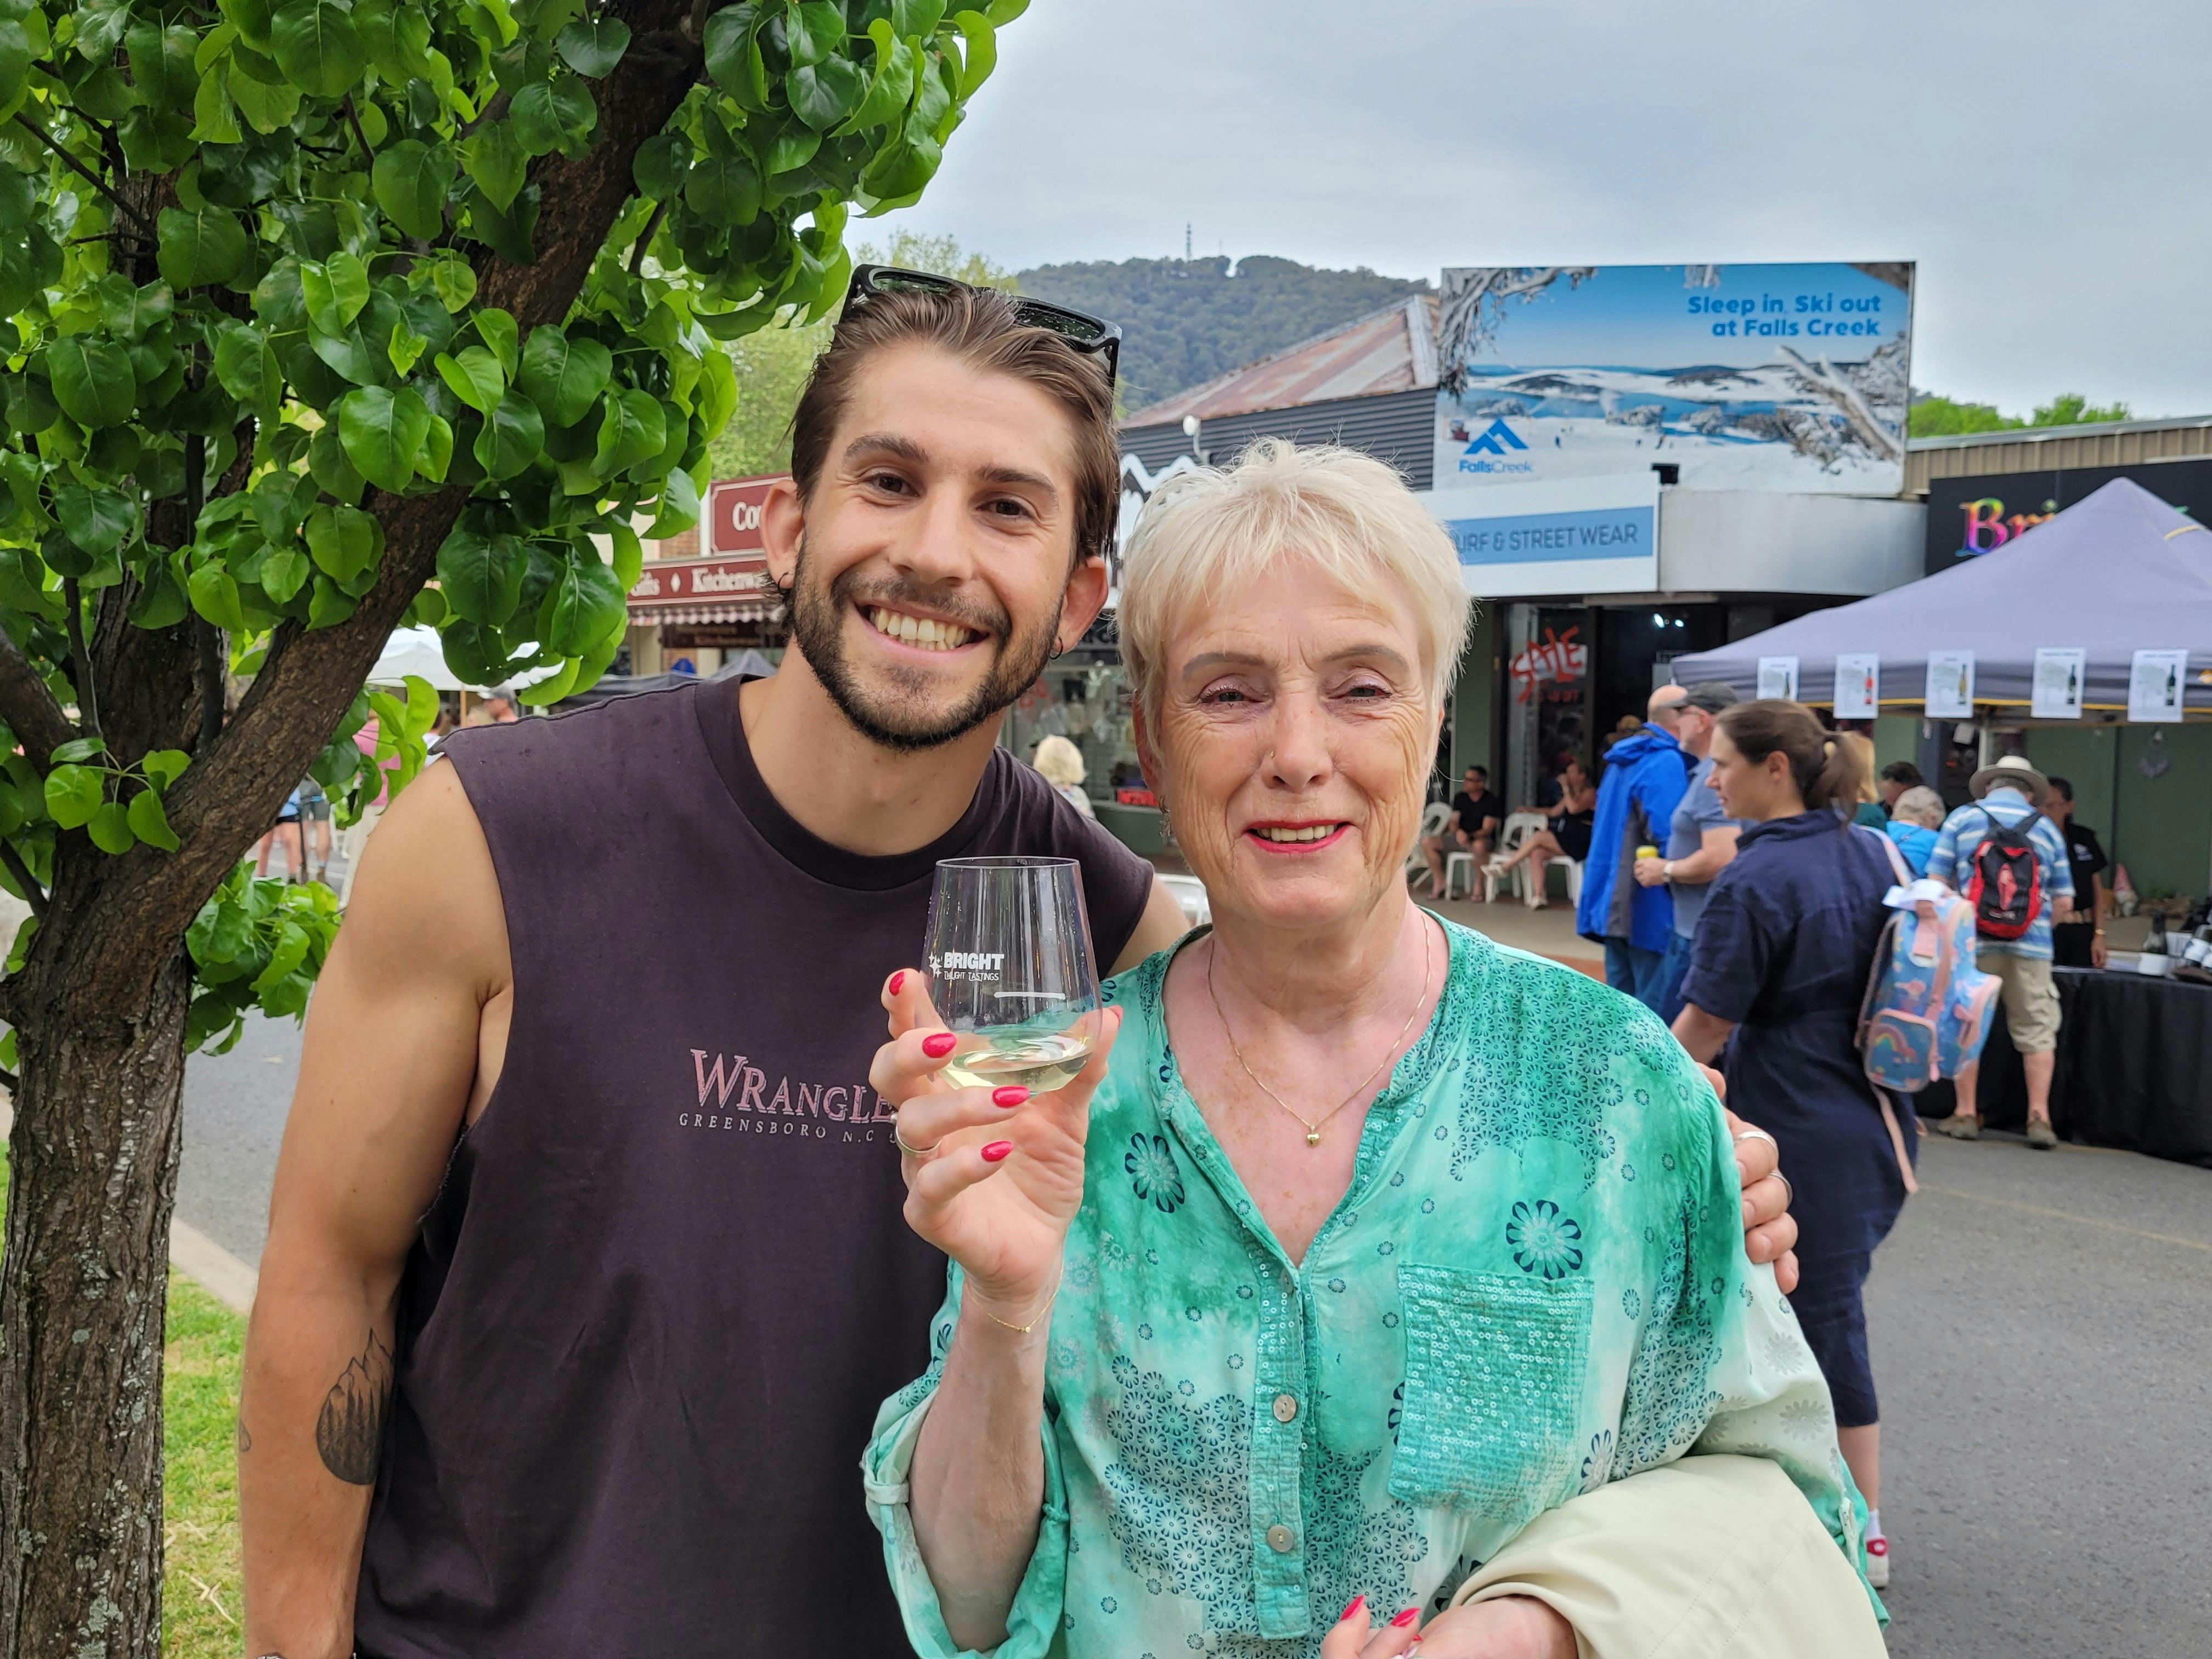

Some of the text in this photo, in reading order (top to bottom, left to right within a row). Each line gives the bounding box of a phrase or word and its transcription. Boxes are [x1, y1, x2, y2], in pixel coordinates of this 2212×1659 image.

[1688, 292, 1881, 316] Sleep in Ski out
[1712, 319, 1880, 337] at Falls Creek
[1492, 531, 1505, 552] &
[1509, 526, 1576, 551] STREET
[1579, 522, 1639, 546] WEAR
[1510, 627, 1582, 704] SALE
[944, 952, 1005, 970] BRIGHT
[968, 971, 999, 981] TASTINGS
[679, 1113, 826, 1138] GREENSBORO
